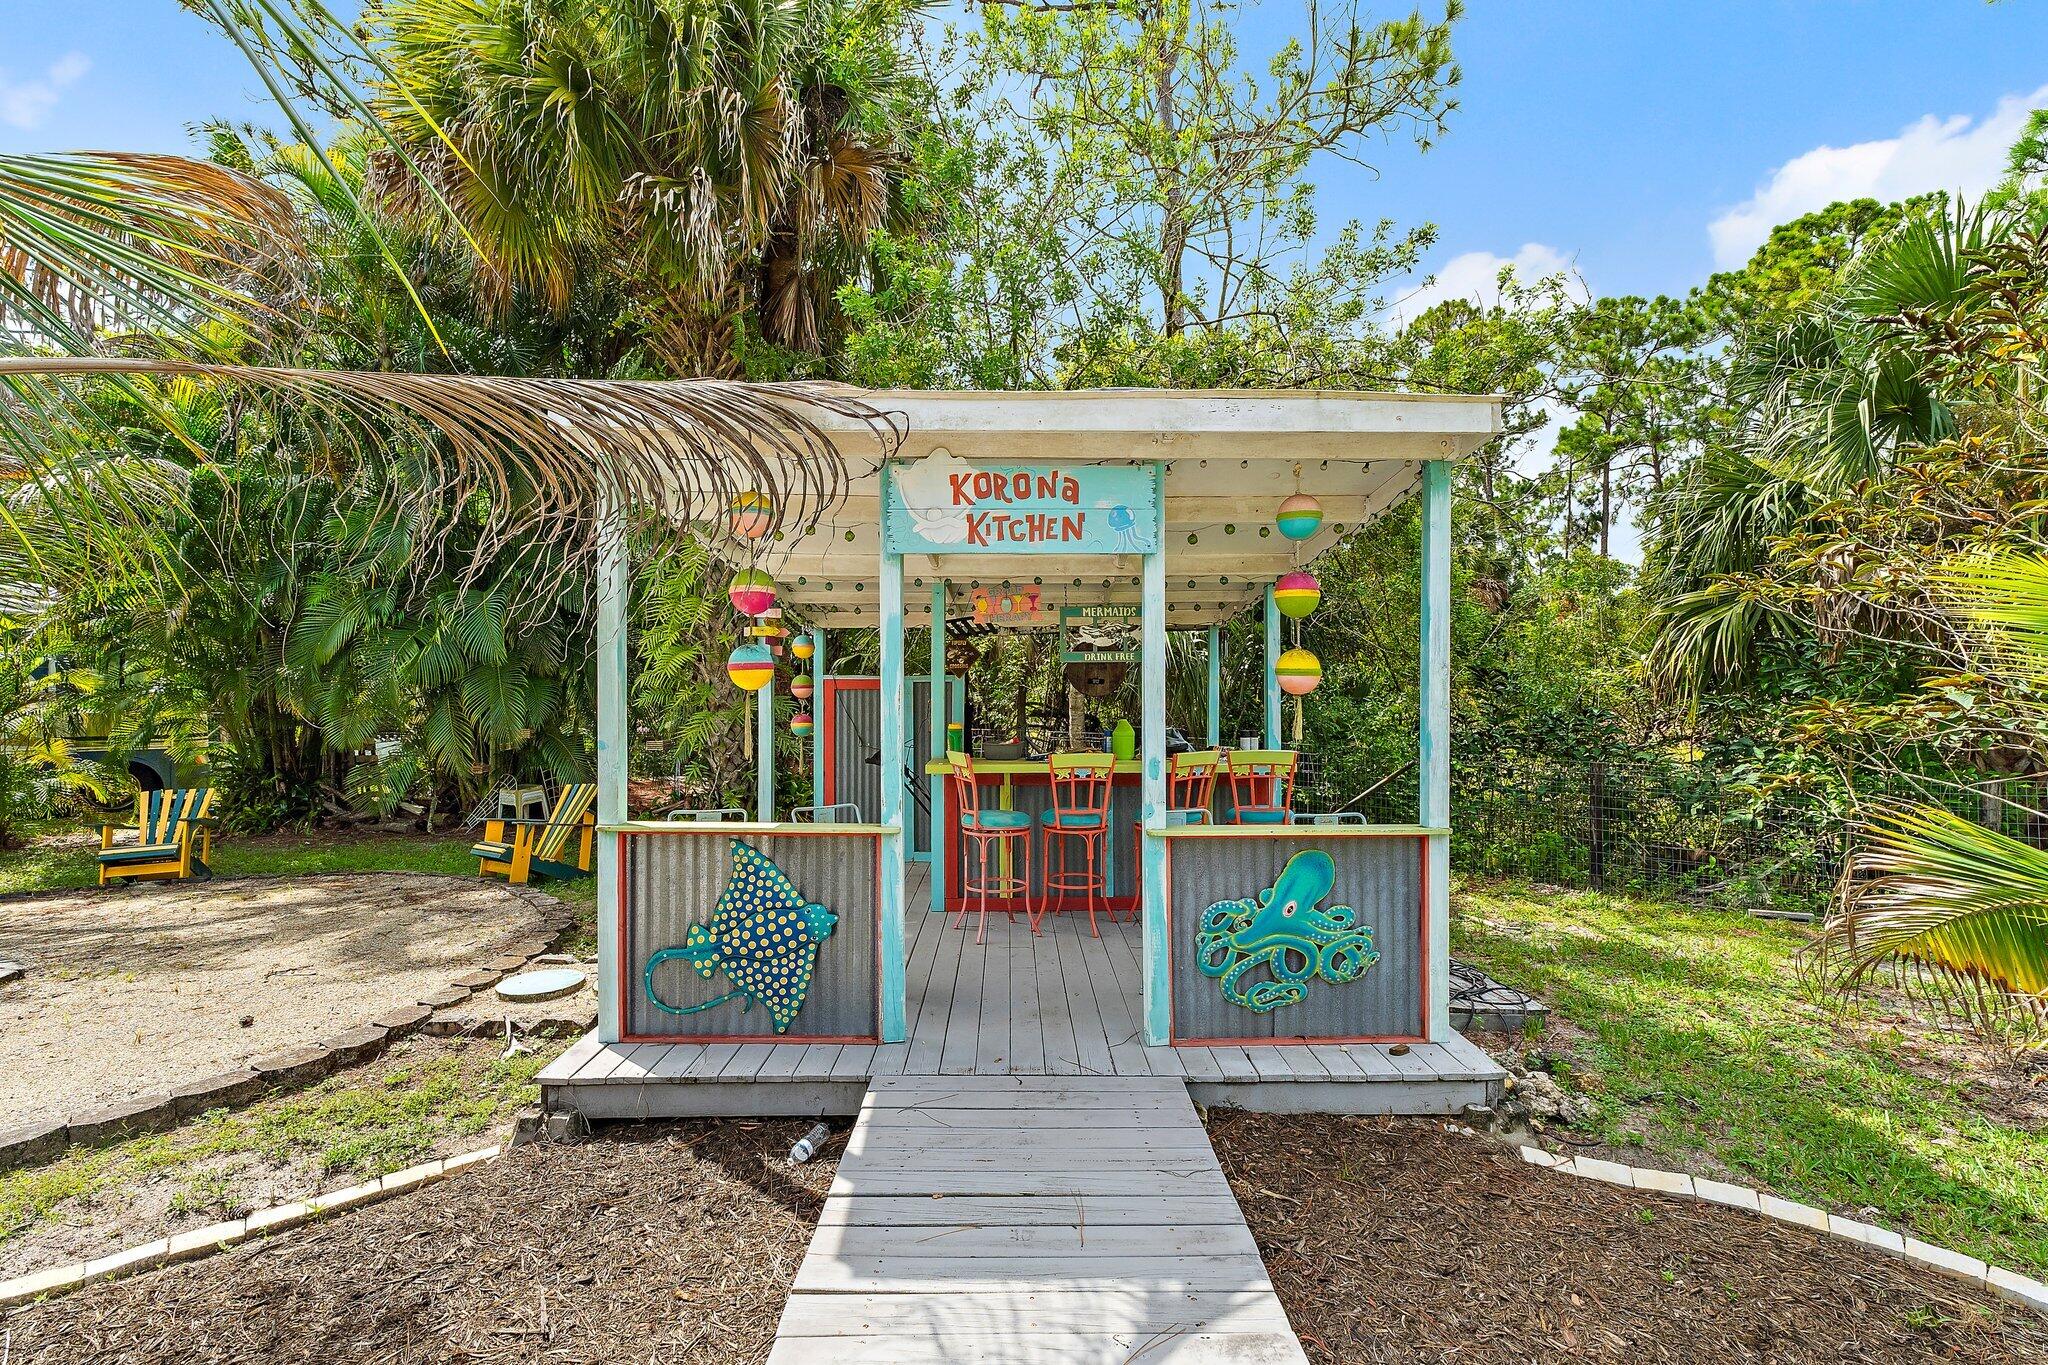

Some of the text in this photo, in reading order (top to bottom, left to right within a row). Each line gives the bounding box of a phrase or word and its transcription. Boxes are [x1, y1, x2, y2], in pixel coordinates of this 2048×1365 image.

[966, 511, 1086, 547] KITCHEN
[1082, 606, 1137, 617] MERMAIDS
[1084, 652, 1135, 661] DRINK FREE
